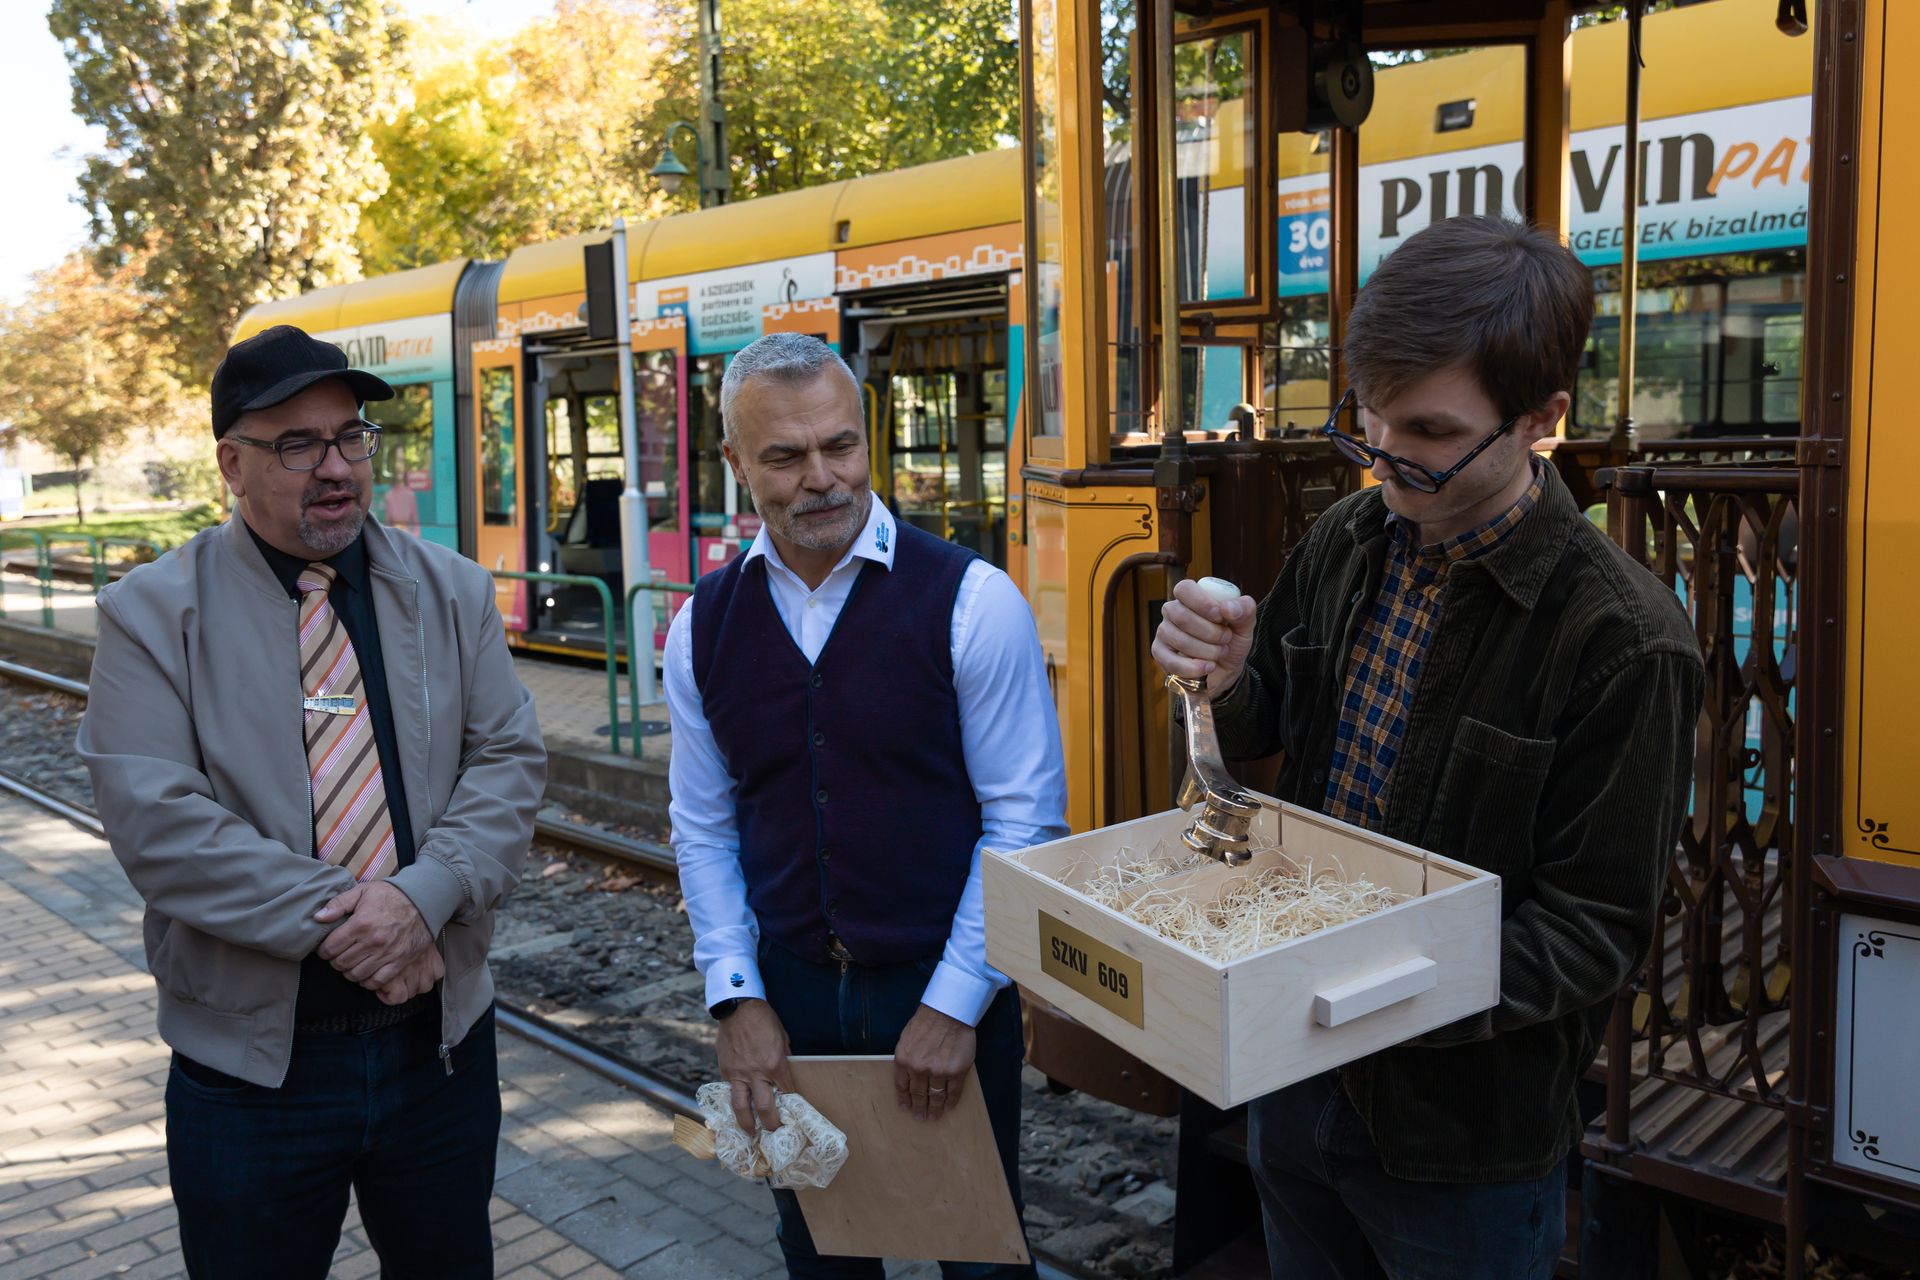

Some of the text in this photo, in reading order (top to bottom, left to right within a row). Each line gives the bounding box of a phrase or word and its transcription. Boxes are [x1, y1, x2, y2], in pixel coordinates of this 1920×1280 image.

[1379, 133, 1716, 239] PINVIN
[1288, 217, 1330, 253] 30
[1569, 220, 1678, 251] GEDEK
[335, 335, 386, 369] GVIN
[1051, 935, 1128, 999] SZKV 609
